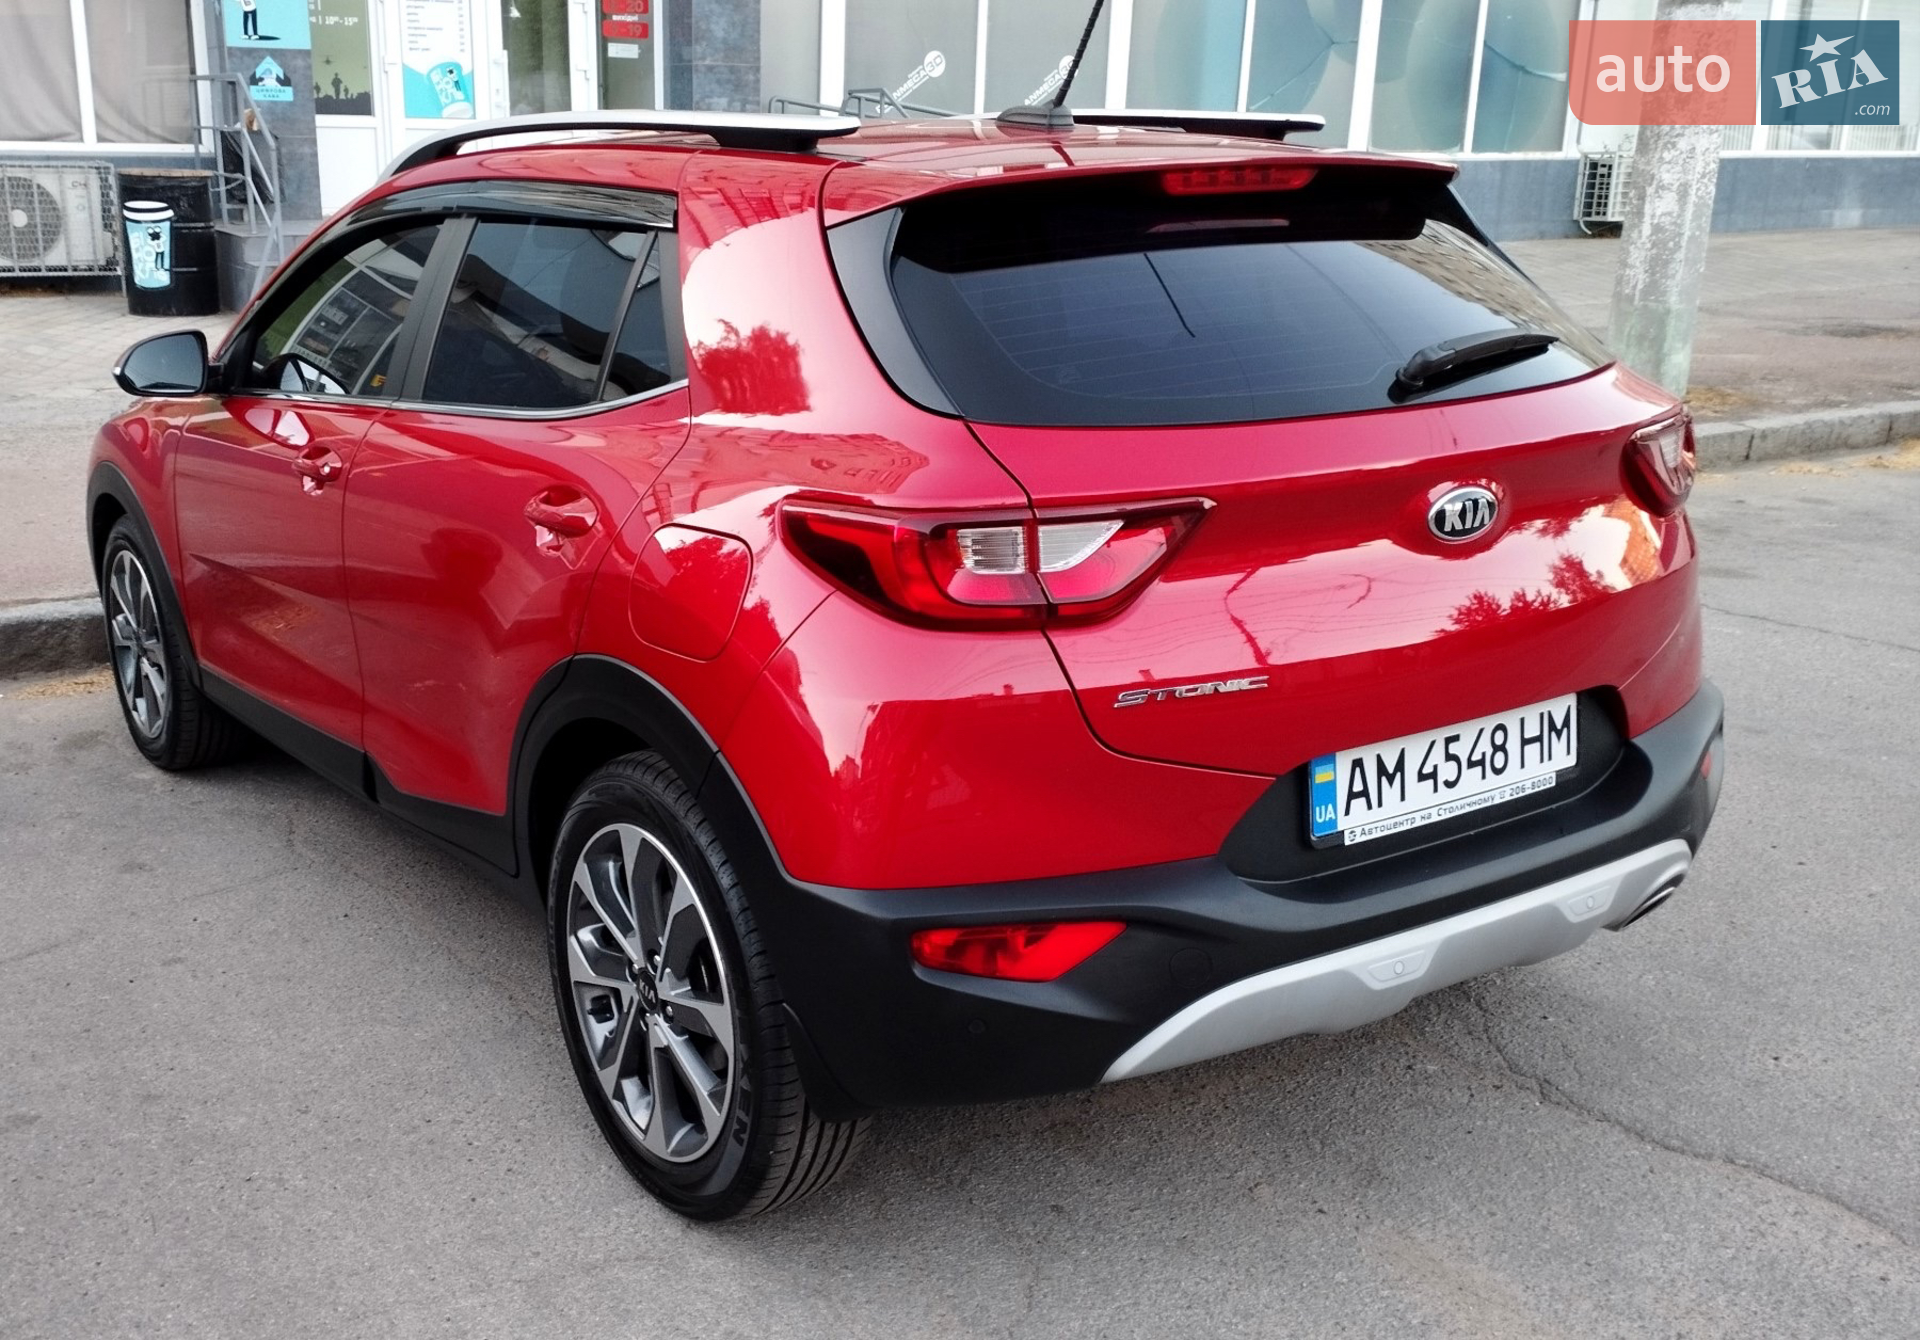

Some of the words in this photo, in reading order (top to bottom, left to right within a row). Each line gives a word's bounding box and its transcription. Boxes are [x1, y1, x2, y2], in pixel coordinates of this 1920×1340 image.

[1443, 498, 1490, 532] KIA
[1113, 675, 1270, 708] STONIC
[1343, 747, 1406, 817] AM
[1417, 722, 1509, 794] 4548
[1519, 704, 1572, 770] HM
[1315, 803, 1336, 824] UA
[1360, 816, 1417, 838] Автоцентр
[1420, 812, 1432, 822] на
[1436, 794, 1497, 817] Столичному
[1509, 776, 1554, 797] 206-8000
